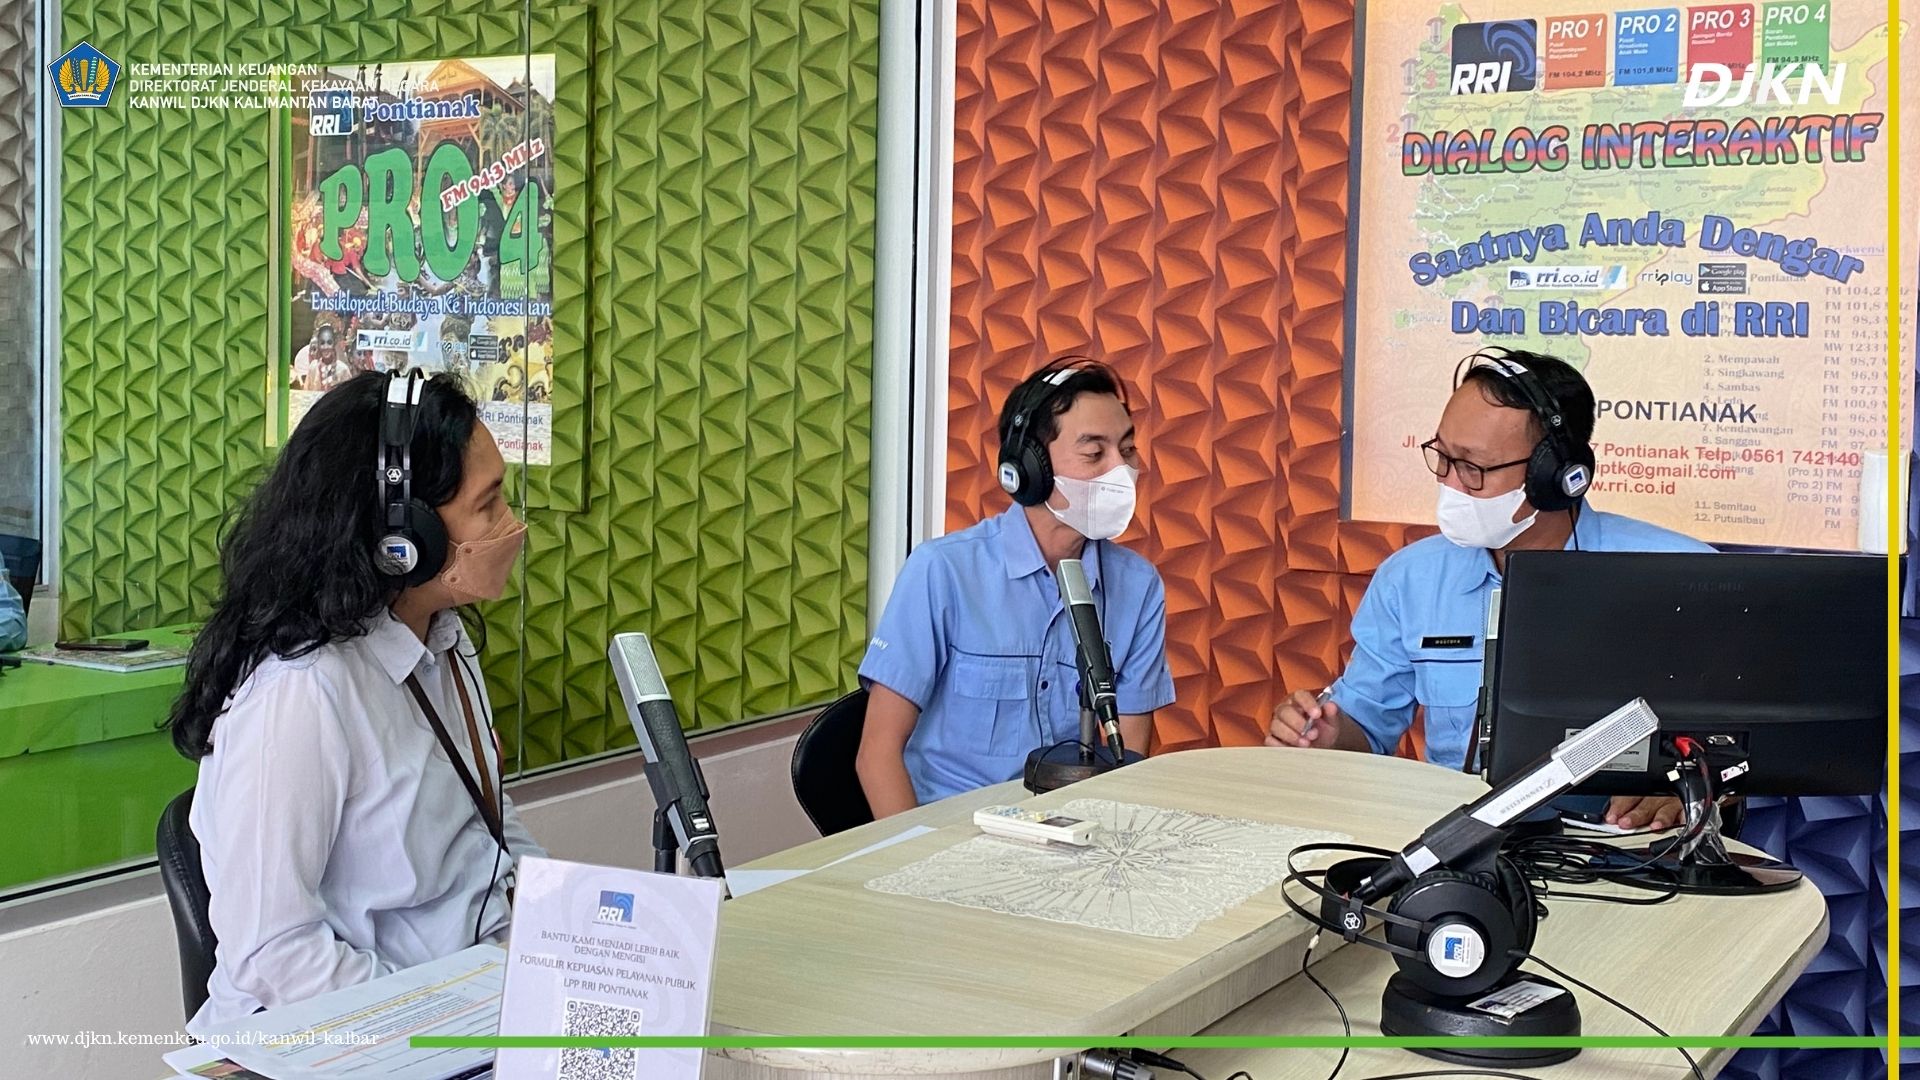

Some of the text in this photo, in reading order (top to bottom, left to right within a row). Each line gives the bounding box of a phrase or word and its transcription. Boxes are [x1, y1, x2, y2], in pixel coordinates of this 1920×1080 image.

[1692, 8, 1751, 31] PRO 3
[1765, 4, 1826, 26] PRO 4
[1549, 18, 1603, 39] PRO 1
[1619, 14, 1677, 34] PRO 2
[1767, 56, 1779, 64] FM
[1451, 61, 1512, 95] RRI
[311, 93, 480, 134] RRI Pontianak
[1402, 113, 1884, 176] DIALOG INTERAKTIF
[440, 181, 470, 212] FM
[319, 142, 539, 283] PRO 4
[1409, 211, 1864, 286] Saatnya Anda Dengar
[1537, 268, 1599, 282] rri.co.id
[1711, 269, 1732, 277] Google
[1712, 285, 1725, 293] App
[1825, 286, 1841, 295] FM
[311, 290, 550, 321] Ensiklopedi Budaya Ke Indonesian
[1825, 301, 1841, 310] FM
[1452, 301, 1809, 338] Dan Bicara di RRI
[1825, 315, 1840, 324] FM
[374, 332, 411, 346] rri.co.id
[1824, 330, 1840, 338] FM
[1824, 343, 1842, 351] MW
[1718, 354, 1780, 365] Mempawah
[1824, 356, 1840, 365] FM
[1718, 368, 1785, 379] Singkawang
[1824, 370, 1839, 379] FM
[1718, 383, 1761, 392] Sambas
[1823, 385, 1839, 394] FM
[1822, 399, 1838, 408] FM
[1597, 400, 1757, 423] PONTIANAK
[1822, 412, 1838, 421] FM
[1716, 424, 1794, 435] Kendawangan
[1821, 427, 1837, 436] FM
[1715, 436, 1761, 447] Sanggau
[1821, 440, 1838, 449] FM
[1604, 443, 1690, 460] Pontianak
[1742, 449, 1784, 463] 0561
[1793, 450, 1859, 466] 742140
[1827, 469, 1843, 478] FM
[1826, 482, 1842, 490] FM
[1825, 495, 1842, 503] FM
[1714, 502, 1757, 512] Semitau
[1824, 507, 1841, 516] FM
[1714, 514, 1766, 525] Putusibau
[1824, 520, 1840, 529] FM
[598, 905, 625, 922] RRI
[541, 931, 680, 960] BANTU KAMI MENJADI LEBIH BAIK
[574, 946, 646, 964] DENGAN MENGISI
[520, 954, 696, 991] FORMULIR KEPUASAN PELAYANAN PUBLIK
[564, 978, 649, 1000] LPP RRI PONTIANAK
